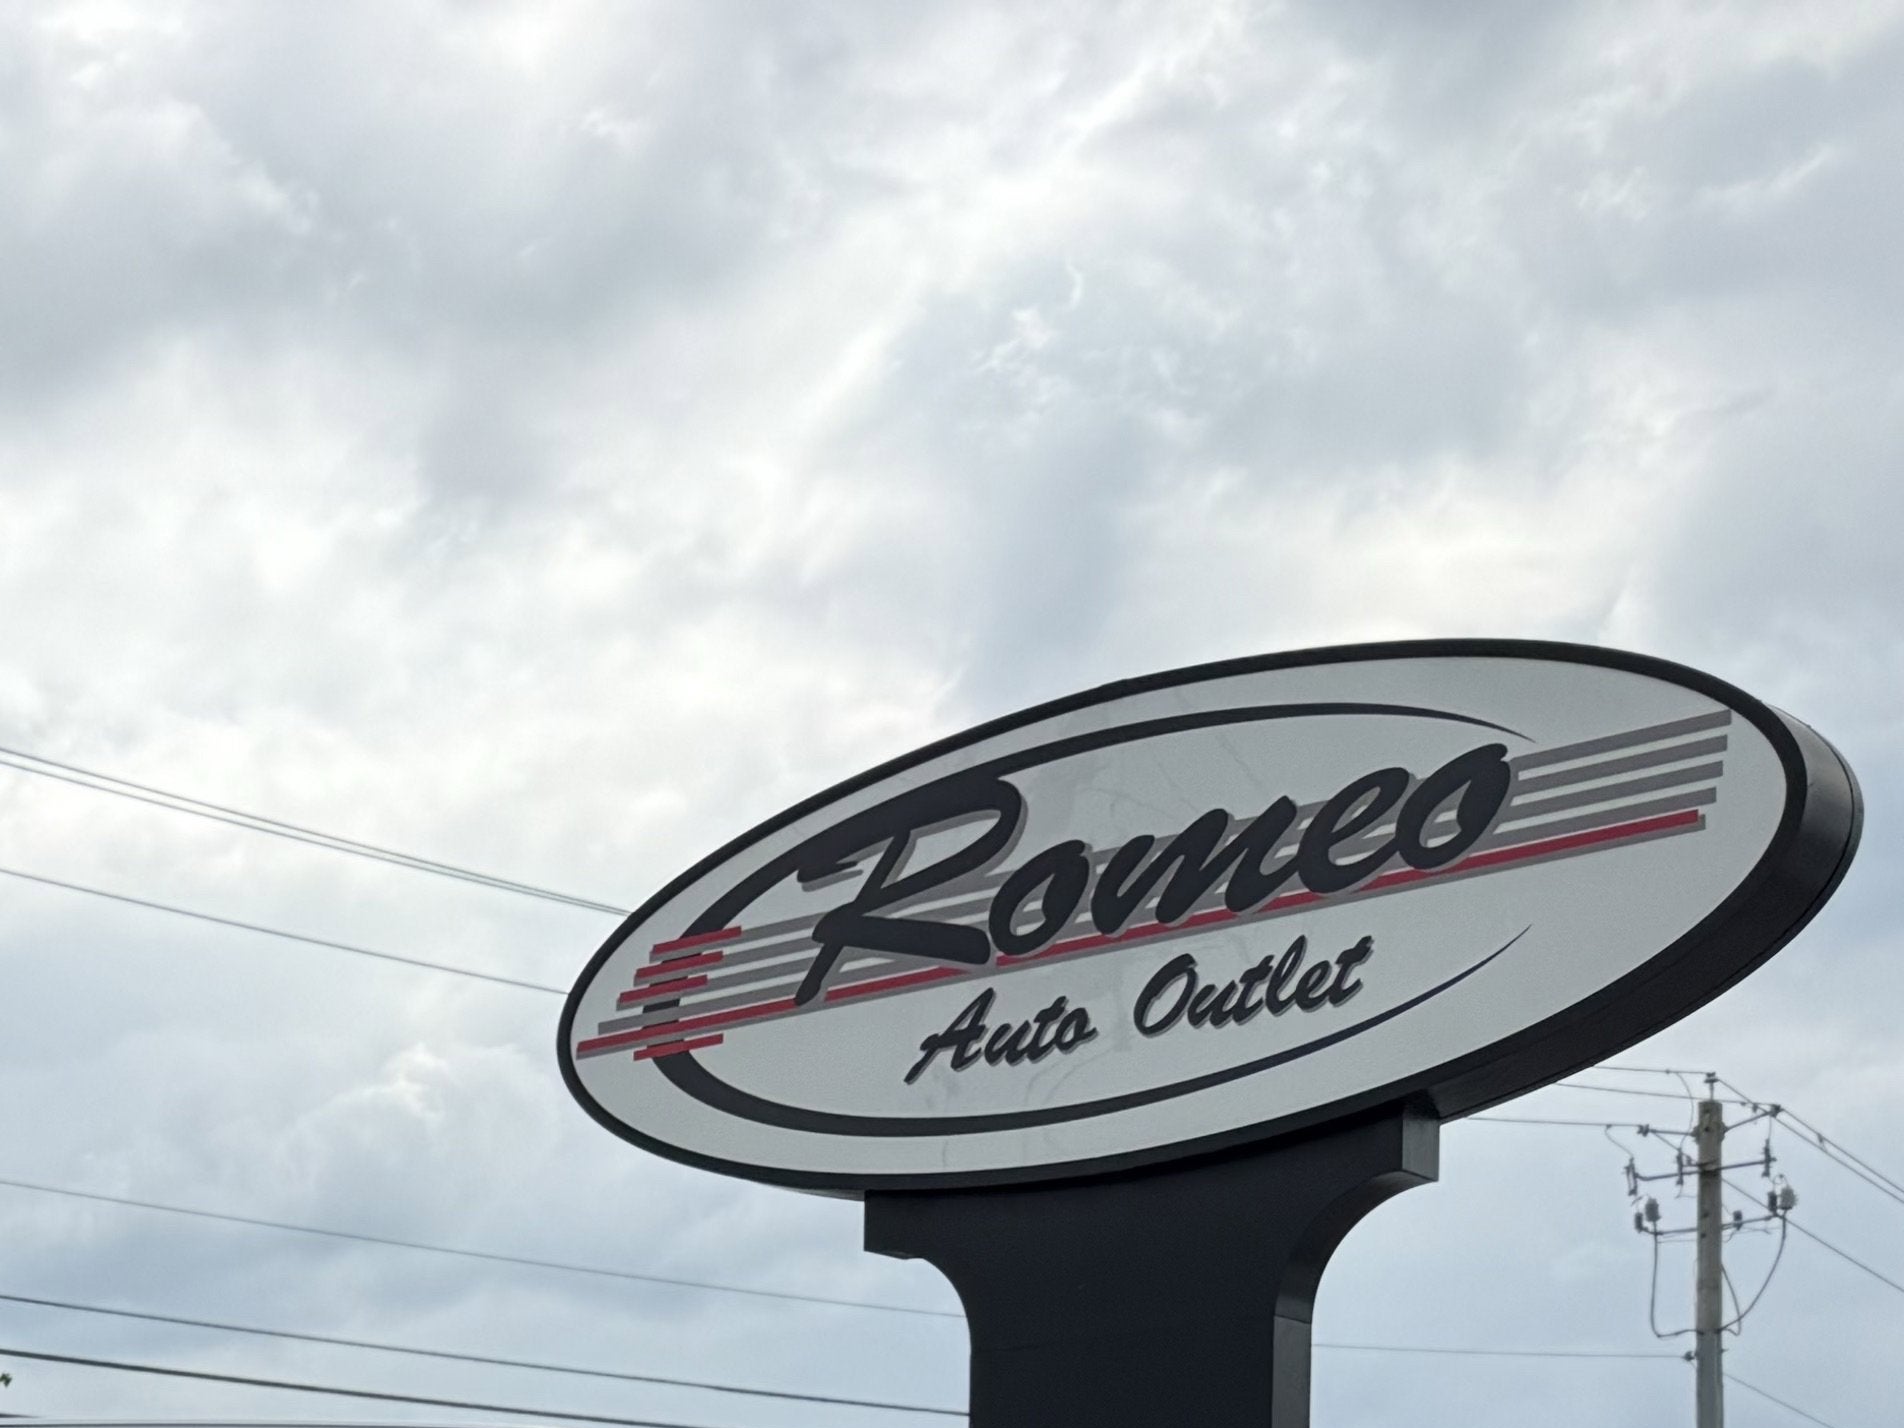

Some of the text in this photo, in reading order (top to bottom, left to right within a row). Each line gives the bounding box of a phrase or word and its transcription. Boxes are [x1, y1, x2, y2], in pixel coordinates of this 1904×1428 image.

[794, 742, 1513, 1006] Romeo
[903, 933, 1375, 1085] Auto Outlet
